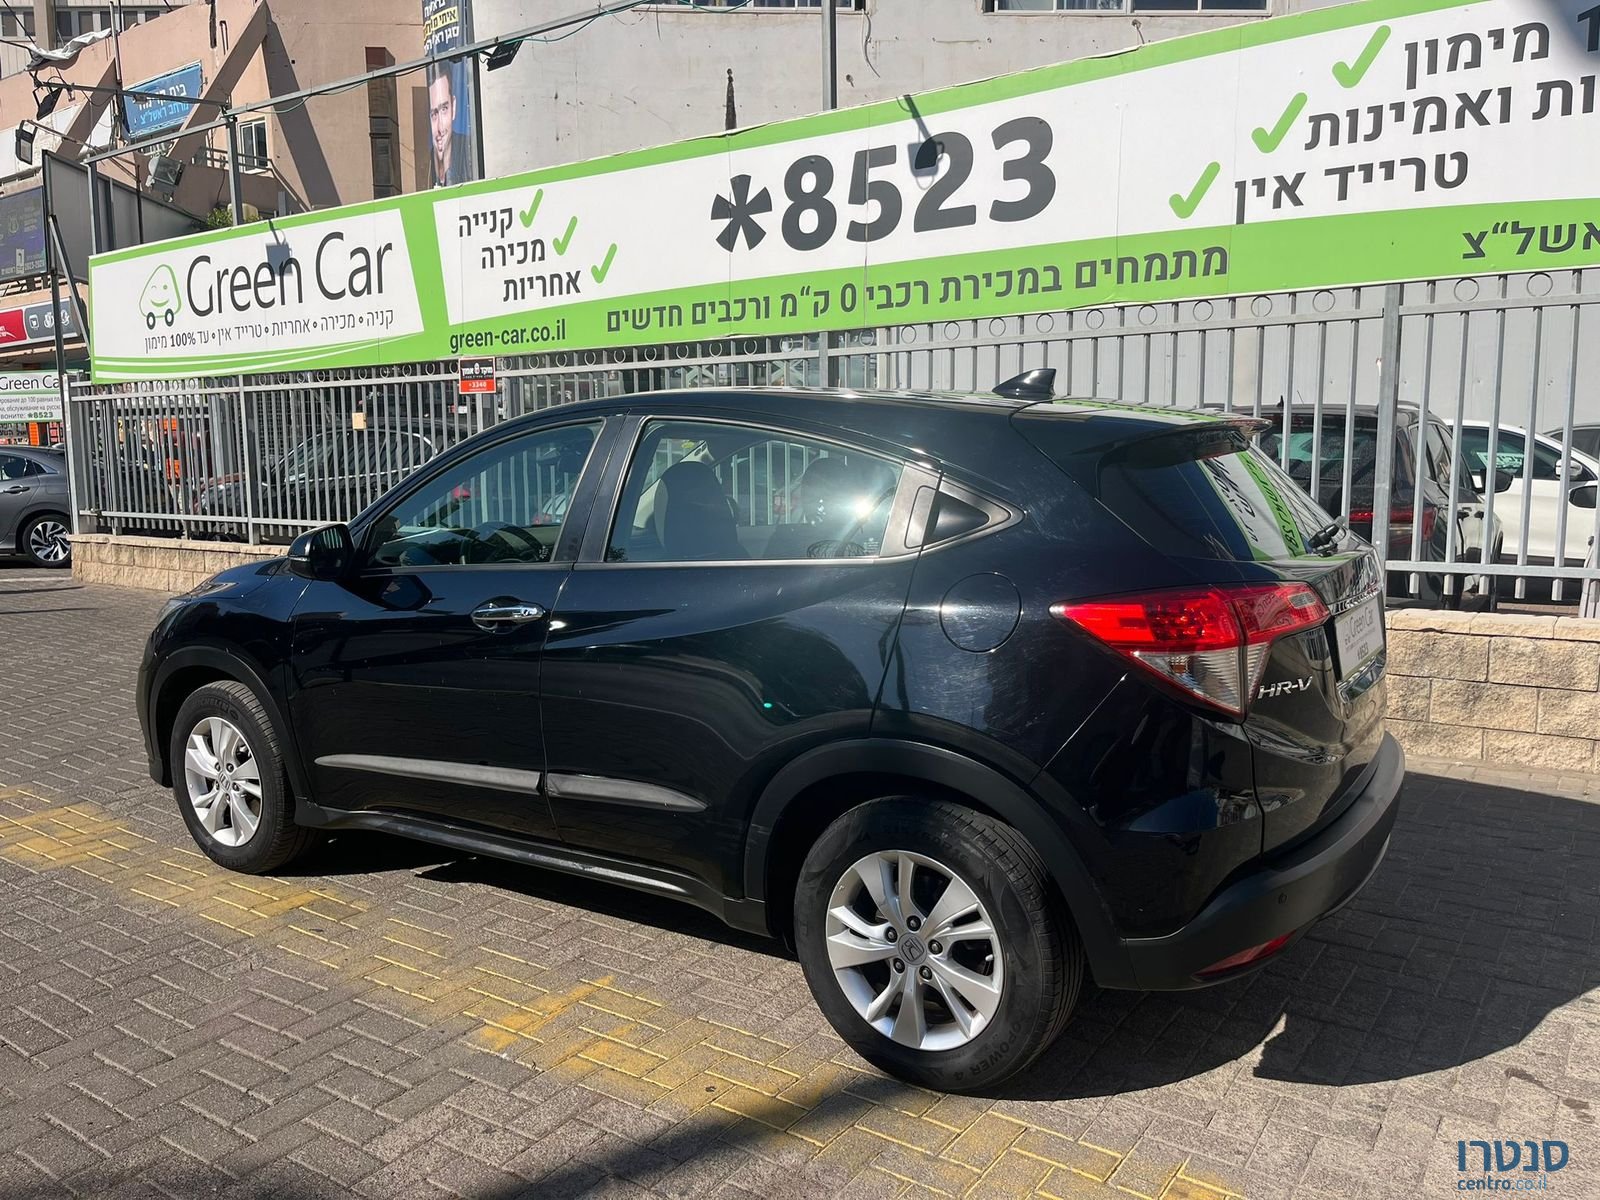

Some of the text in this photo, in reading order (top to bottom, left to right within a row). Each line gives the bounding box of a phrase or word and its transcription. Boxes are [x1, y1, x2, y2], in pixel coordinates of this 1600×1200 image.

[1404, 22, 1550, 90] מימון
[1304, 86, 1512, 151] ואמינות
[1235, 151, 1468, 224] טרייד אין
[459, 207, 513, 238] קנייה
[187, 231, 392, 317] Green Car
[481, 239, 545, 269] מכירה
[503, 270, 581, 302] אחריות
[607, 246, 1228, 332] מתמחים במכירת רכבי 0 ק"מ ורכבים חדשים
[145, 309, 394, 354] קניה מכירה אחריות טרייד אין עד 100% מימון
[450, 318, 566, 354] green-car.co.il
[43, 375, 59, 389] Ca
[1258, 676, 1313, 699] HR-V
